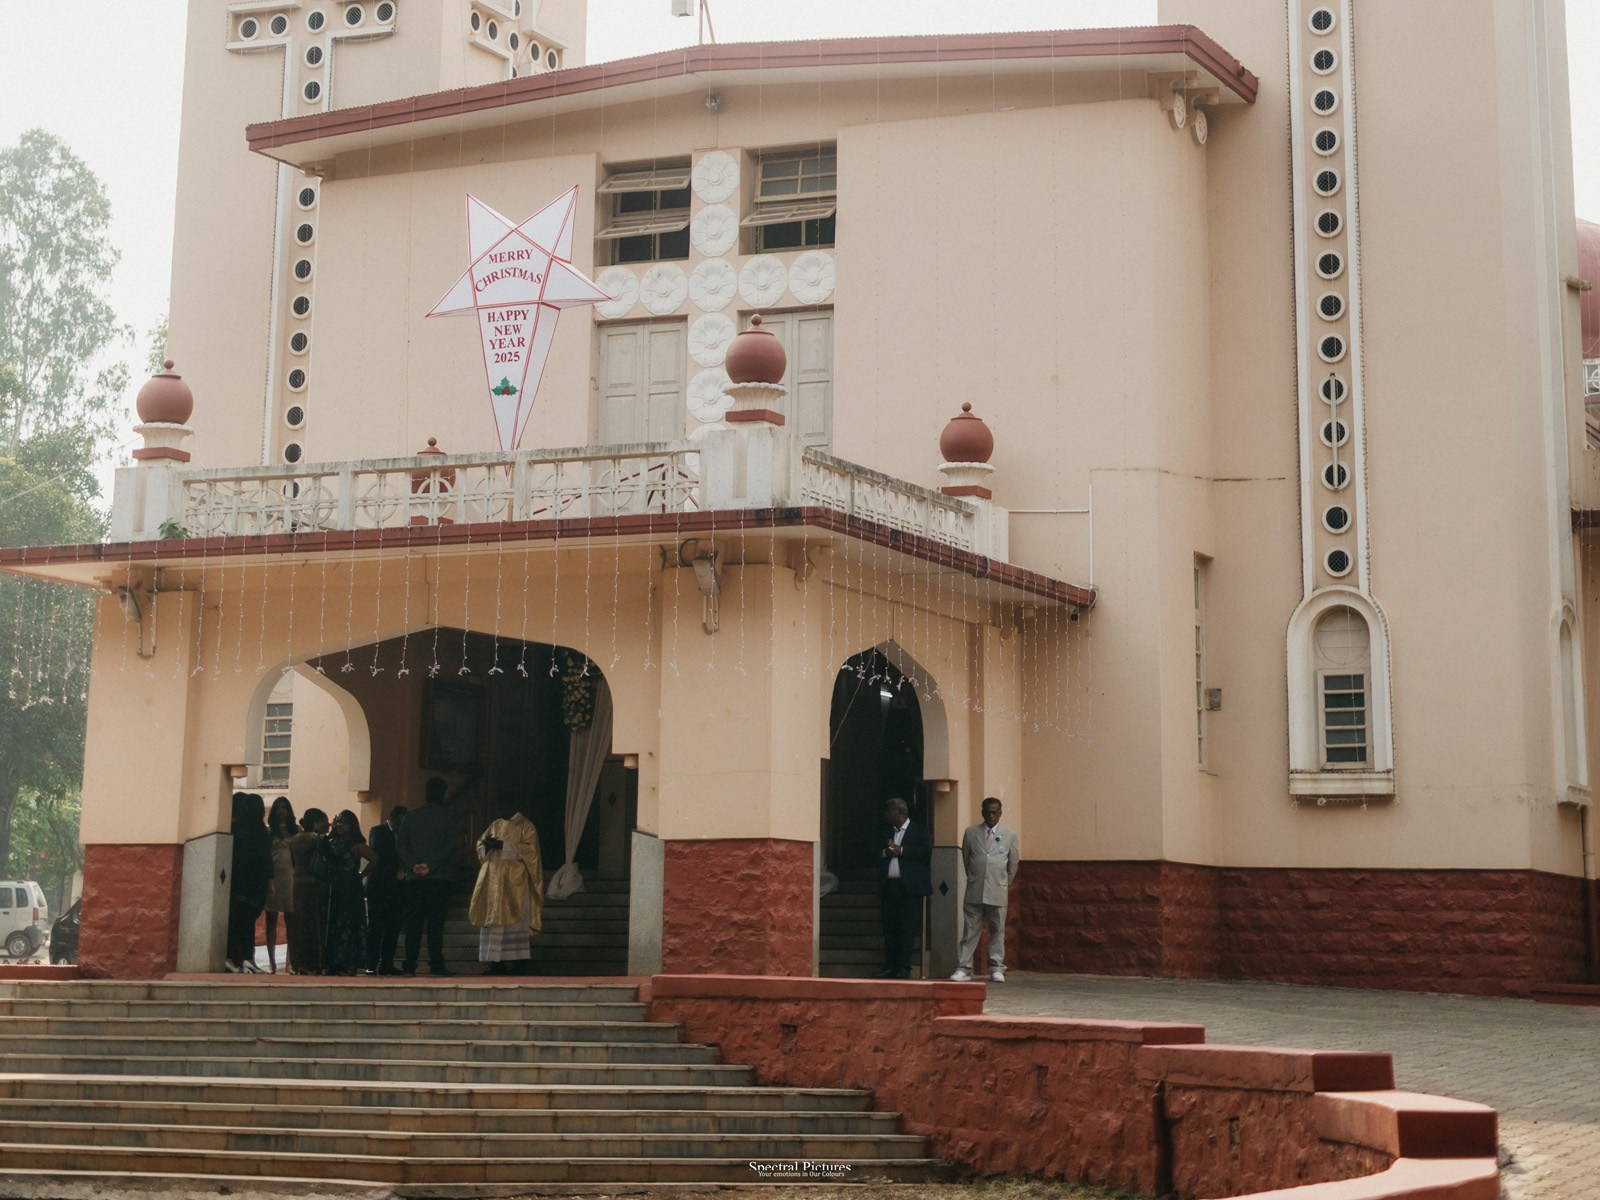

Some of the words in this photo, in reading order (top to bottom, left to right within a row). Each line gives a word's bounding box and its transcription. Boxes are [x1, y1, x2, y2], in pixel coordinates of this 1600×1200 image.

[488, 249, 534, 264] MERRY
[475, 267, 543, 293] CHRISTMAS
[487, 309, 530, 323] HAPPY
[494, 324, 523, 336] NEW
[489, 338, 526, 350] YEAR
[494, 351, 520, 364] 2025
